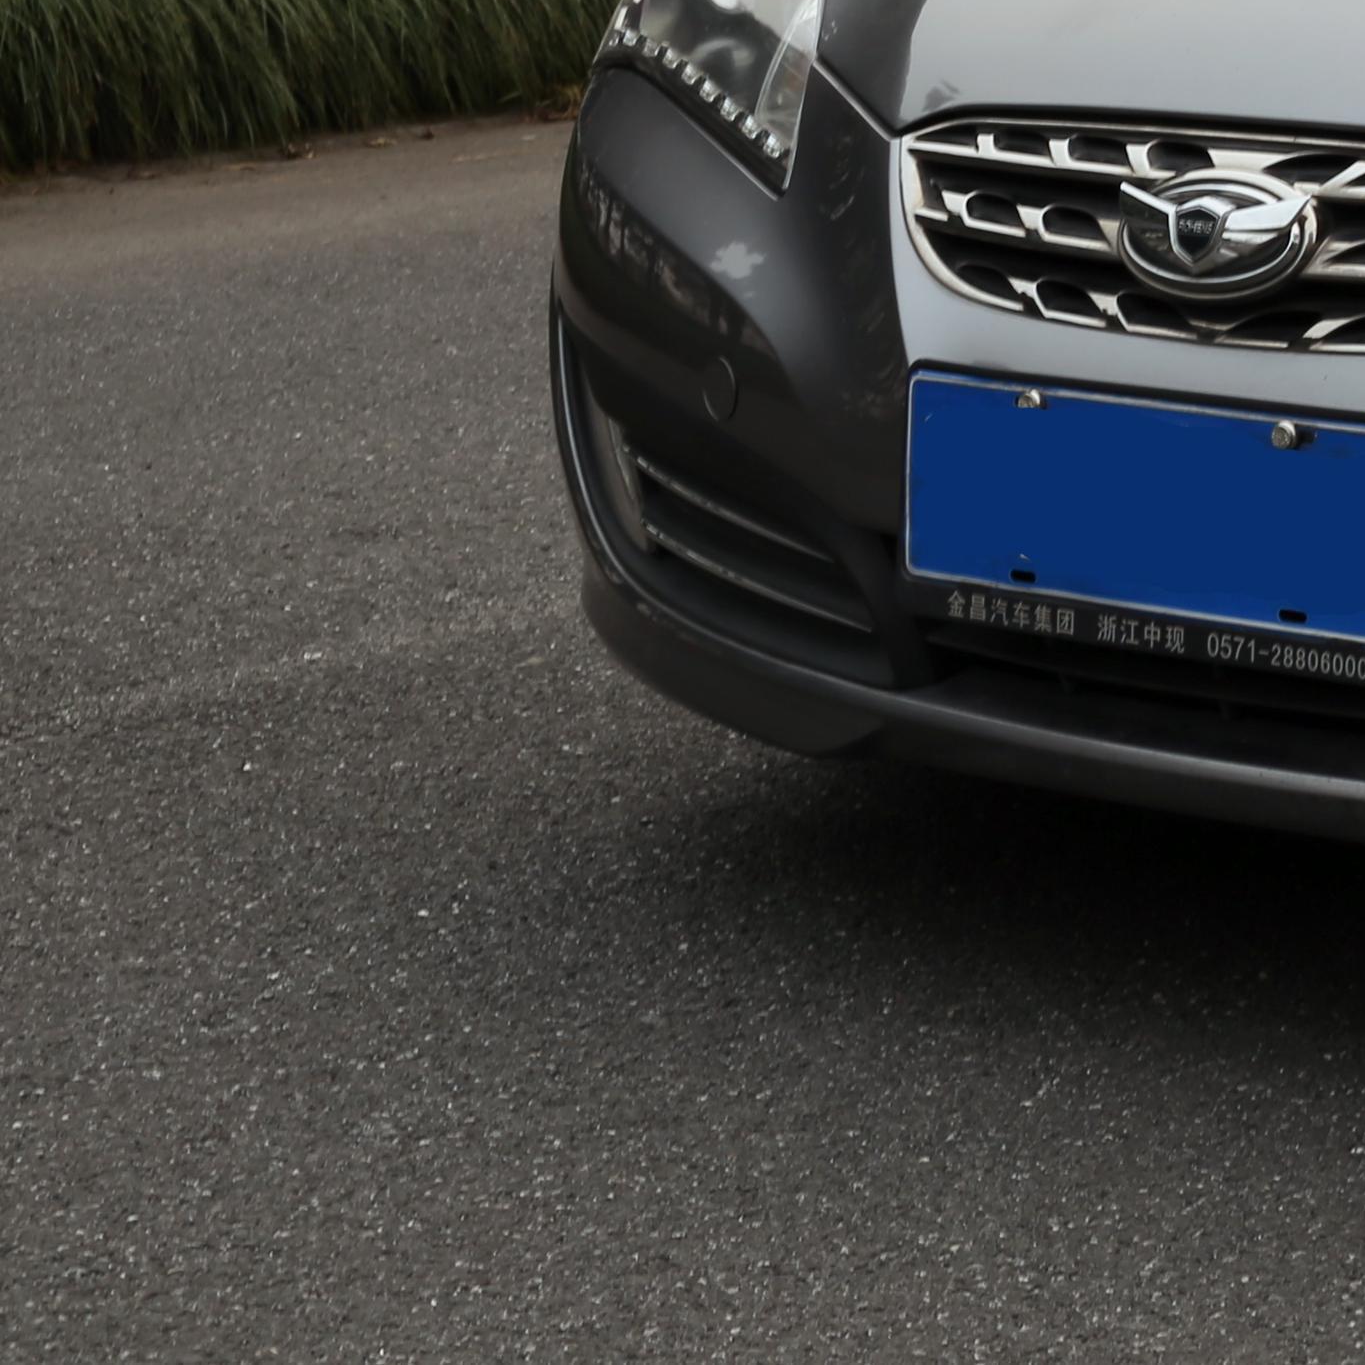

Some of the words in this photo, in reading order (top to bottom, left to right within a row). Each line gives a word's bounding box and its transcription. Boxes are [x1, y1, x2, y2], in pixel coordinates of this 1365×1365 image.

[947, 590, 1075, 636] 金昌汽车集团
[1097, 614, 1185, 654] 浙江中现
